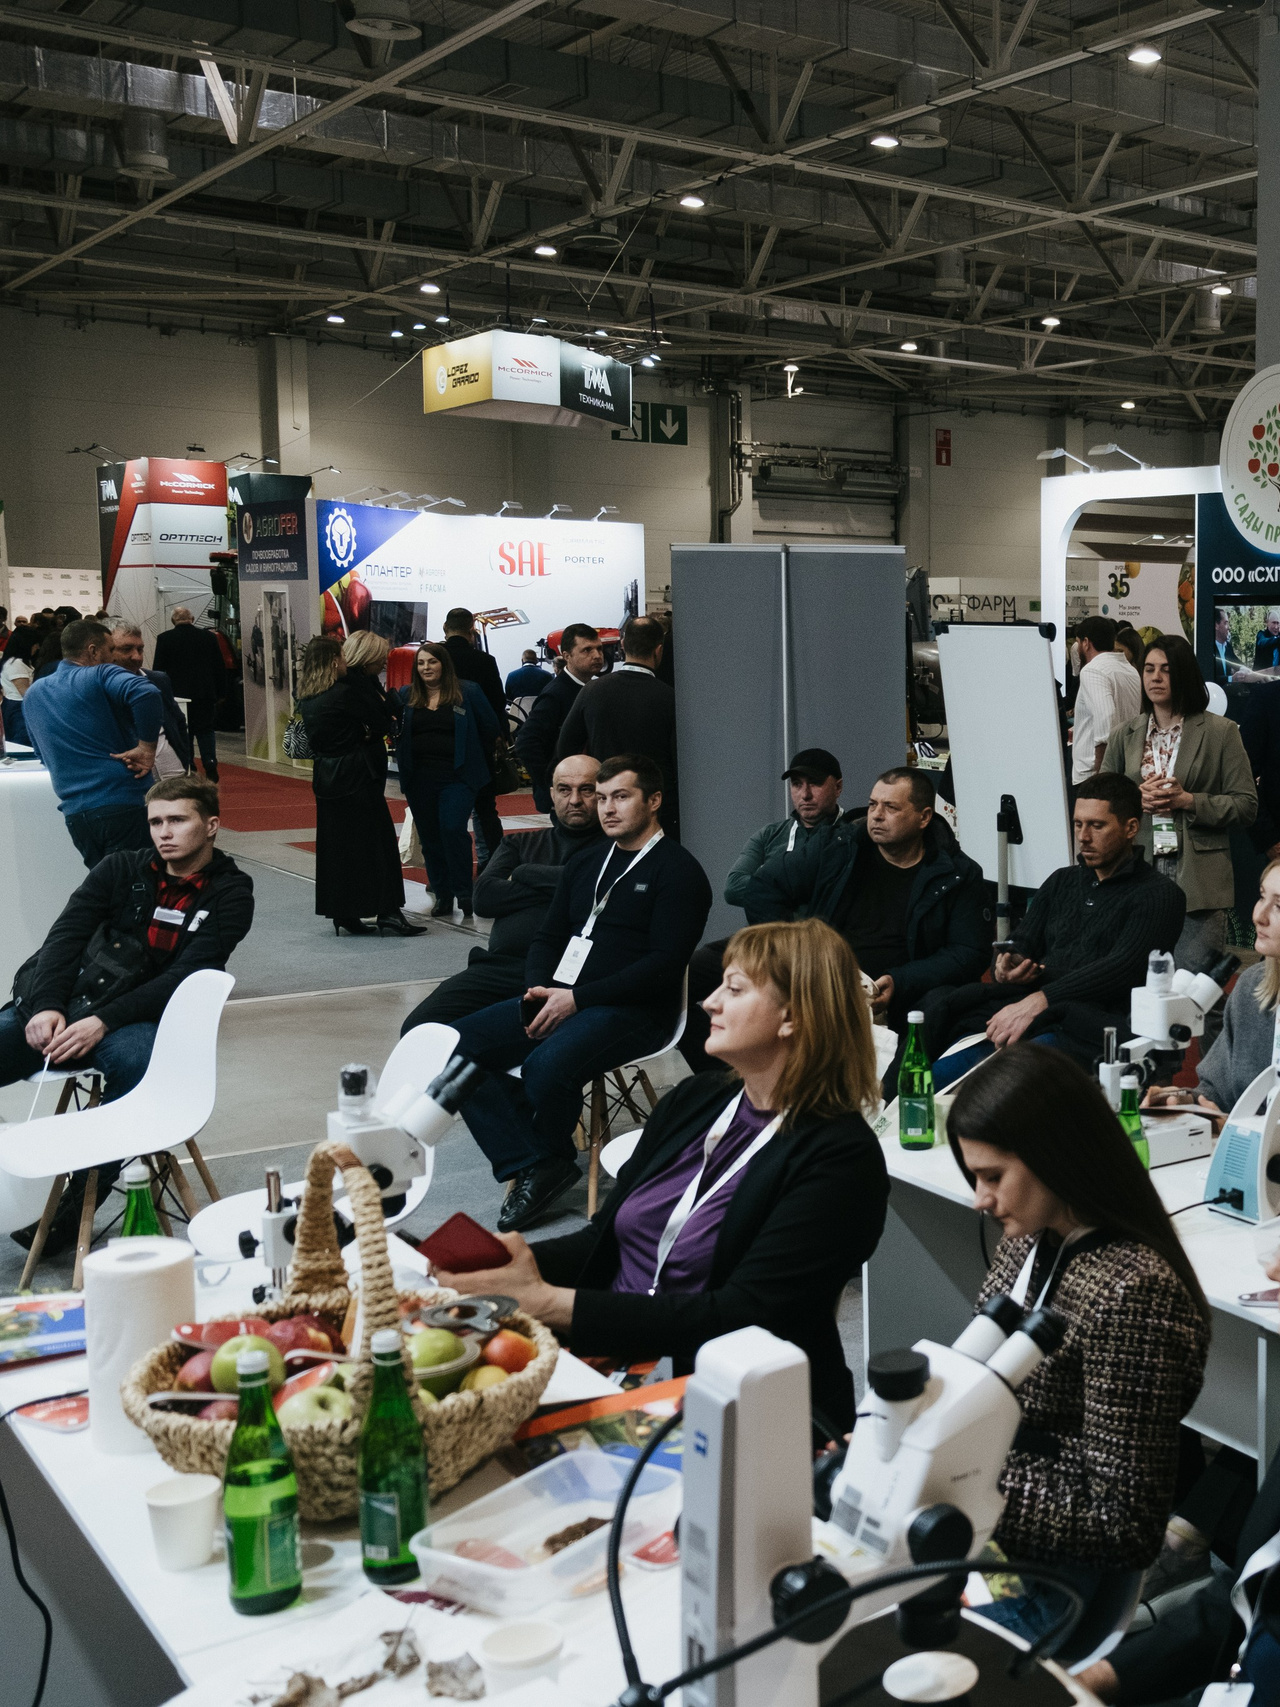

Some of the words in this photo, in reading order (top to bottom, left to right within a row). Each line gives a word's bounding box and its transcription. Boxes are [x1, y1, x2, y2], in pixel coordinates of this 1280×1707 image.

[447, 363, 469, 378] LOPEZ
[452, 372, 480, 388] GARRIDO
[578, 392, 615, 412] ТЕХНИКА-МА
[1234, 493, 1264, 534] САДЫ
[255, 512, 298, 538] AGROFER
[159, 533, 223, 544] OPTITECH
[498, 539, 552, 577] SAE
[564, 555, 605, 565] PORTER
[365, 564, 412, 578] ПЛАНТЕР
[1211, 566, 1245, 584] ООО
[1107, 572, 1131, 598] 35
